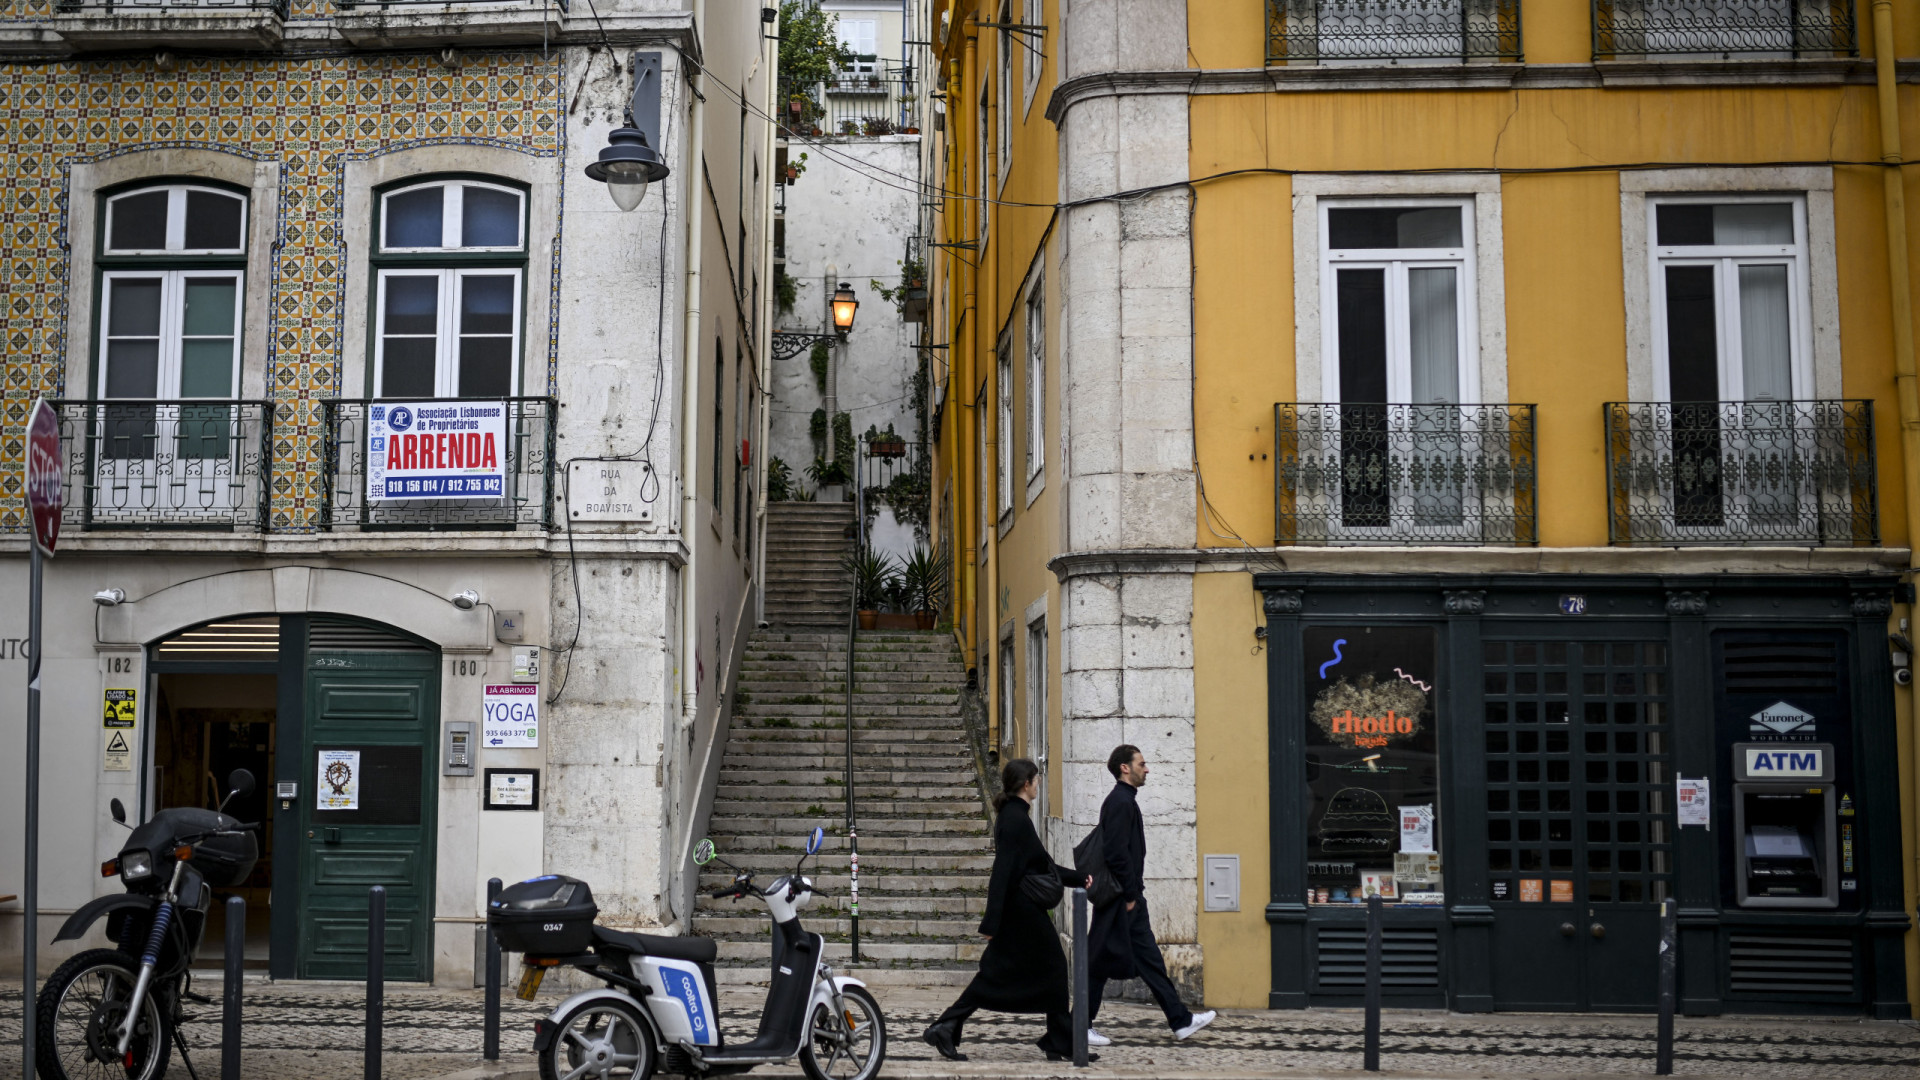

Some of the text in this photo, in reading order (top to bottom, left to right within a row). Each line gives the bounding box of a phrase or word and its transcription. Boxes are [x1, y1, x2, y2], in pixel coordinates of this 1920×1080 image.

[416, 406, 500, 419] Associação Lisbonense
[416, 418, 479, 432] de Proprietários
[387, 432, 497, 470] ARRENDA
[31, 441, 61, 510] STOP
[600, 469, 621, 479] RUA
[388, 478, 500, 493] 918 156 014 / 912 755 842
[604, 486, 617, 496] DA
[586, 503, 633, 513] BOAVISTA
[1569, 596, 1584, 613] 78
[502, 619, 515, 628] AL
[107, 657, 131, 673] 182
[452, 660, 477, 676] 180
[488, 685, 535, 694] JÁ ABRIMOS
[484, 702, 536, 722] YOGA
[1760, 711, 1805, 723] Euronet
[1332, 710, 1413, 734] rhodo
[1753, 752, 1817, 771] ATM
[543, 923, 564, 932] 0347
[682, 976, 698, 1014] cooltra
